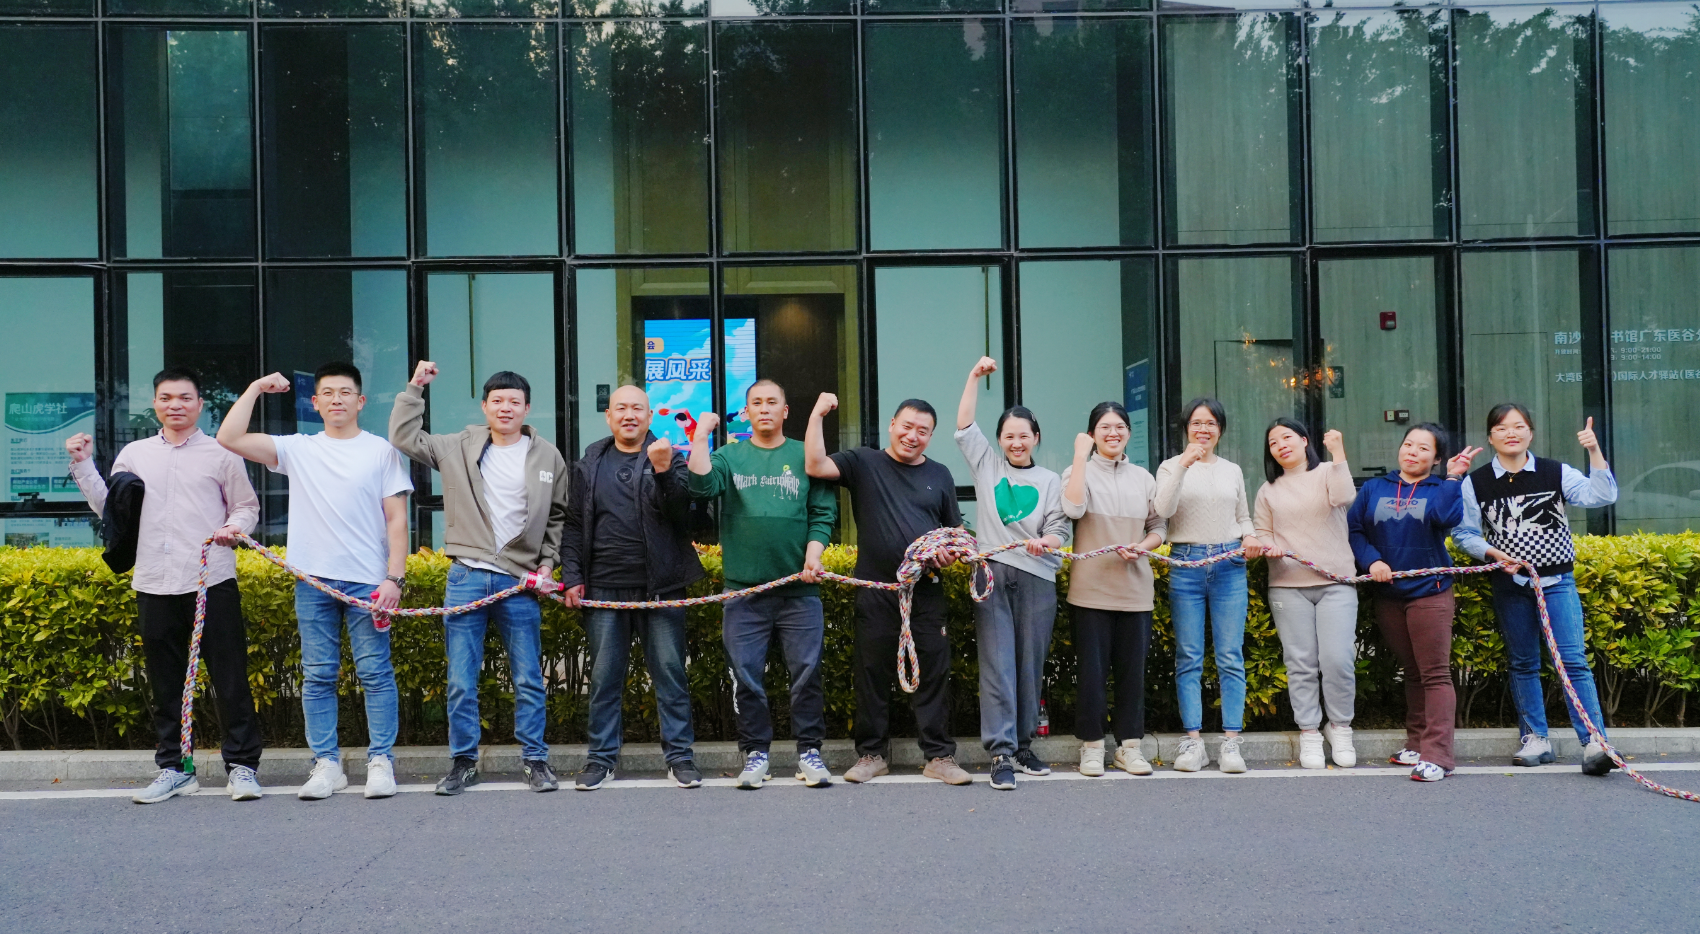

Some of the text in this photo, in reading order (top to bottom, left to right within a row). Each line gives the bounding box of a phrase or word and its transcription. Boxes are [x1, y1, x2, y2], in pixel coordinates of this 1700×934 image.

[646, 340, 656, 350] 会
[645, 359, 711, 381] 展风采
[9, 402, 68, 415] 爬山虎学社
